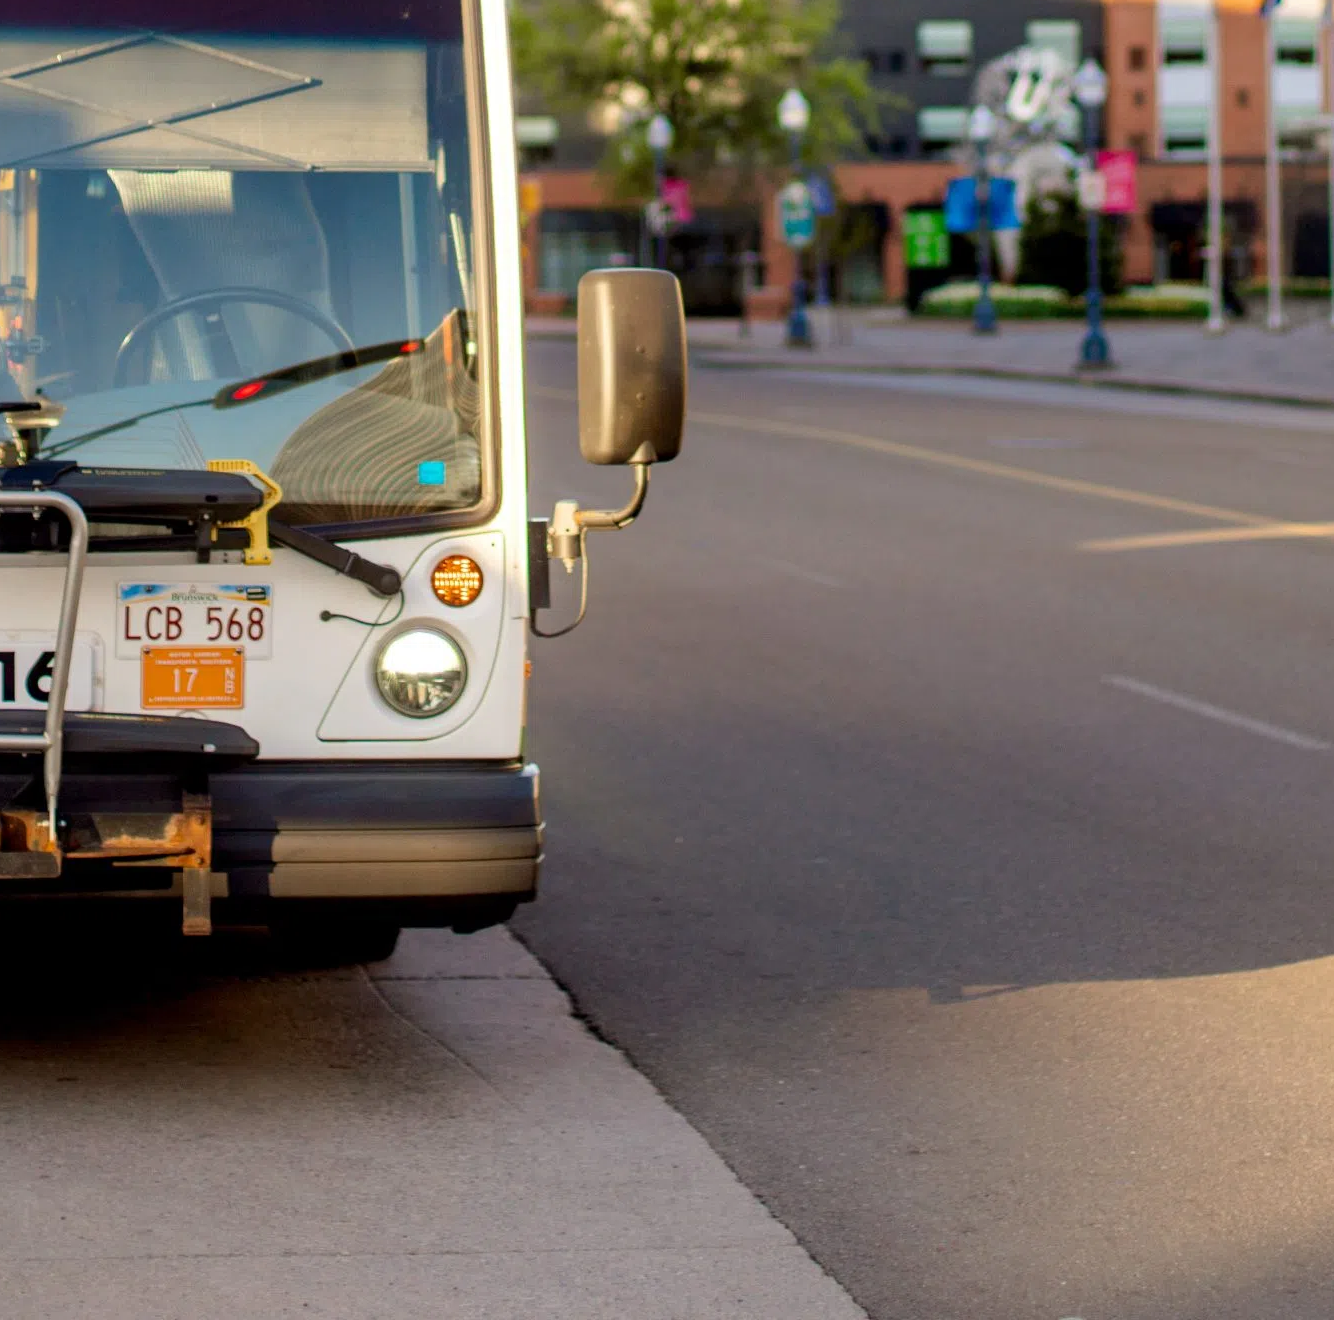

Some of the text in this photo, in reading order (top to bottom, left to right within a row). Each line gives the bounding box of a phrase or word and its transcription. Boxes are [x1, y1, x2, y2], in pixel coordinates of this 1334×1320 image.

[124, 606, 264, 642] LCB 568
[173, 668, 199, 693] 17
